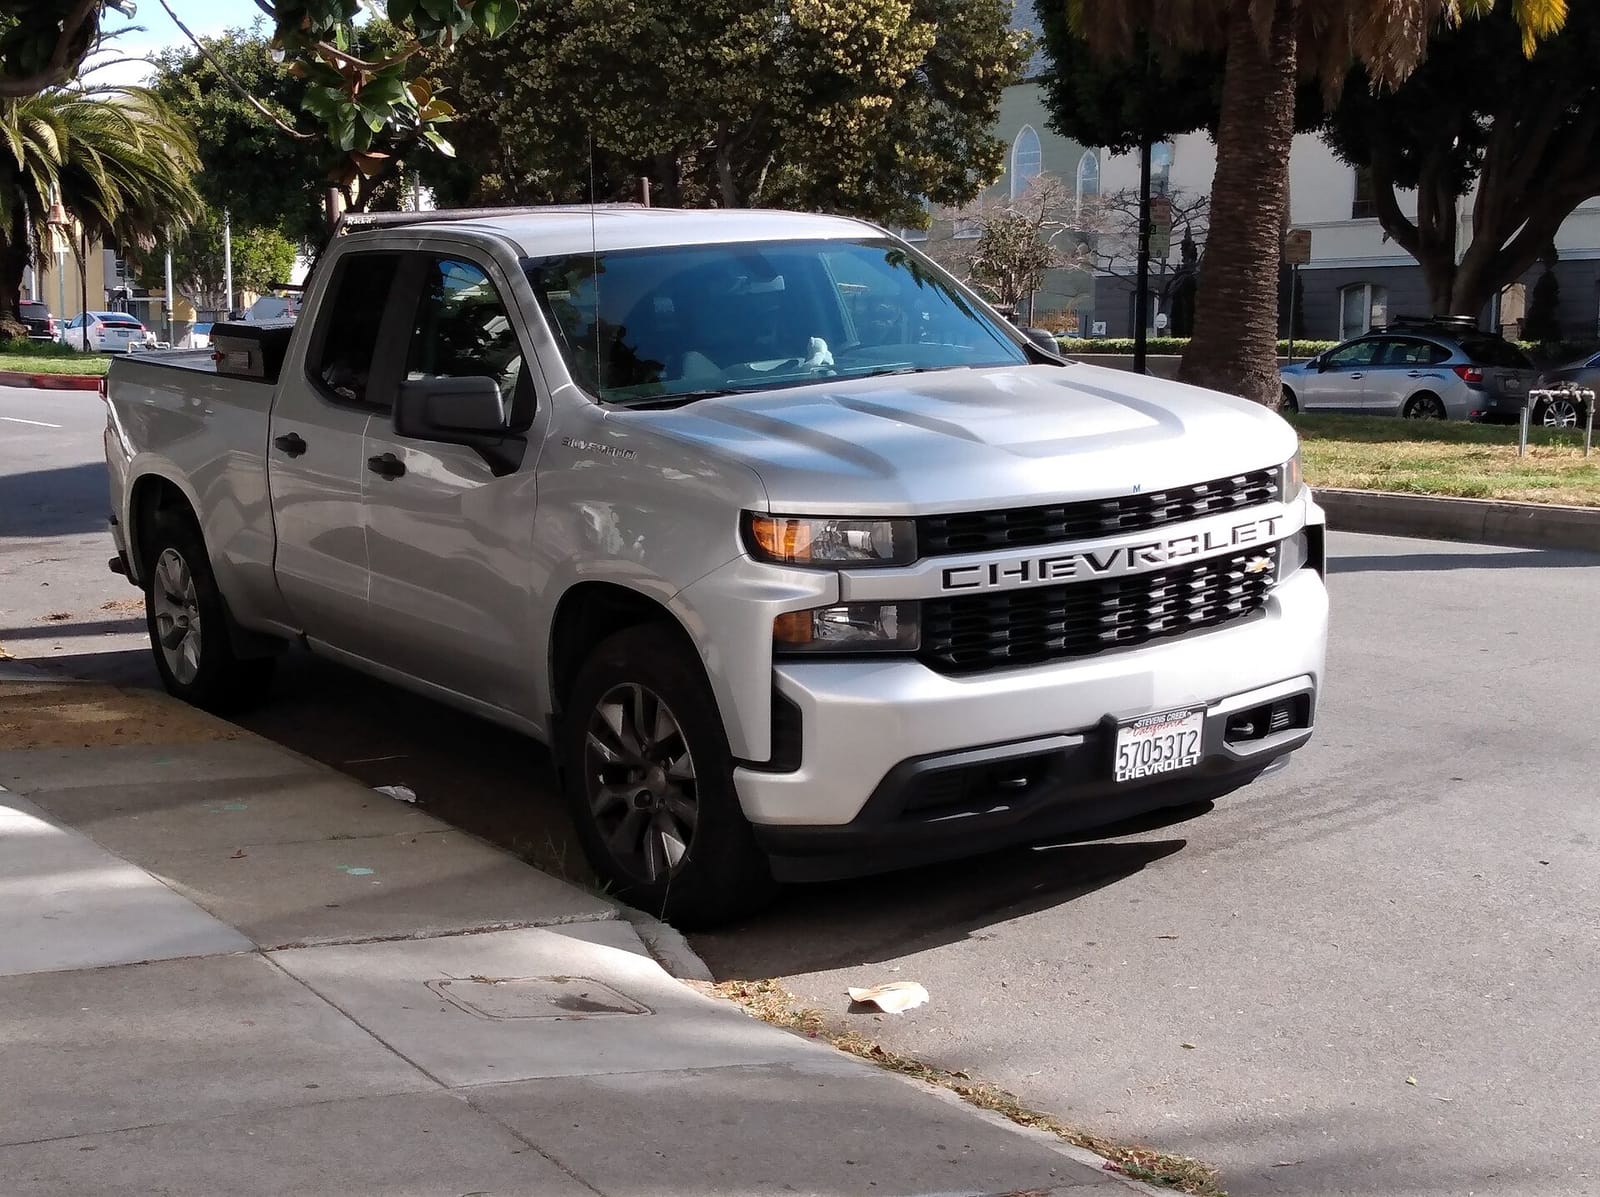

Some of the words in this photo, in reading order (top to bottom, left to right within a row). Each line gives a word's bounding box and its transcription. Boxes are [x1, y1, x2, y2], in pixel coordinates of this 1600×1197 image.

[940, 514, 1284, 591] CHEVROLET
[1116, 753, 1201, 782] CHEVROLET
[1119, 730, 1198, 770] 57053T2
